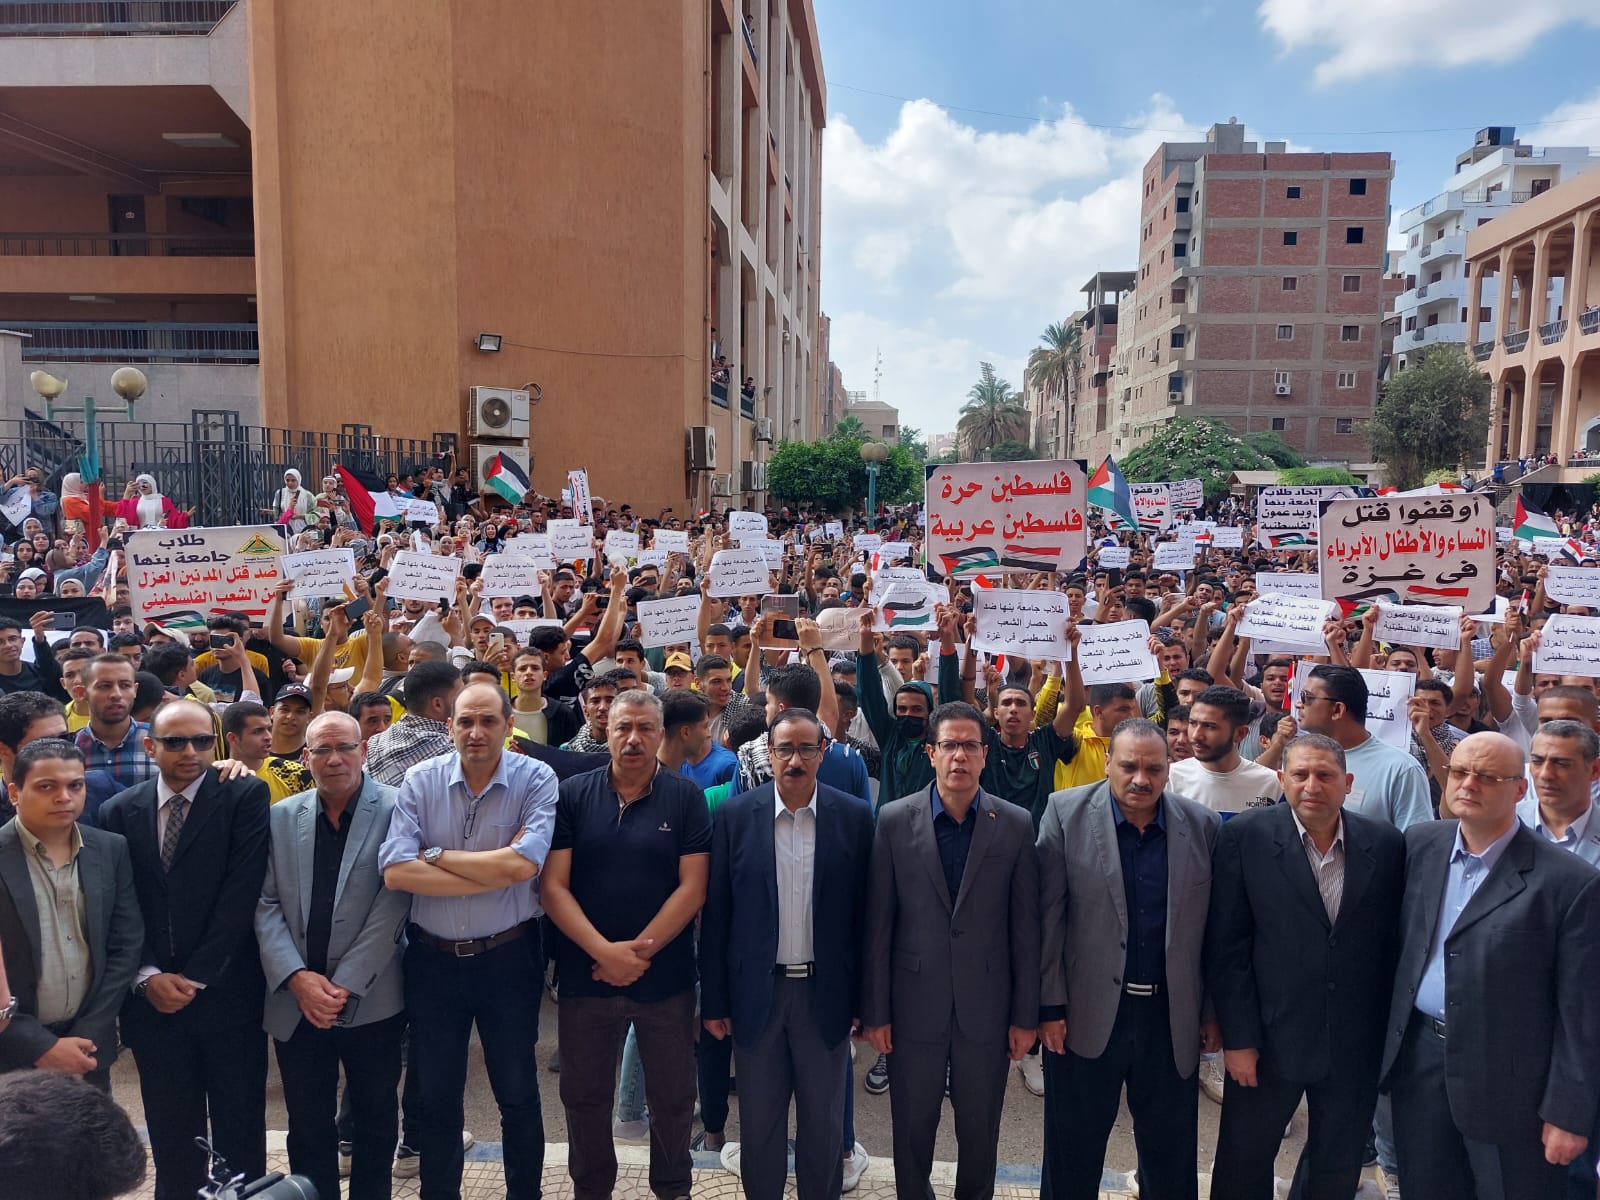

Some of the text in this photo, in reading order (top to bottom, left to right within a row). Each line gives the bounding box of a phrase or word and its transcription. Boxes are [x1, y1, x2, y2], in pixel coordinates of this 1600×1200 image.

[941, 470, 1072, 504] فلسطين حرة
[1264, 488, 1292, 497] طلاب
[1264, 499, 1285, 507] بنها
[1342, 497, 1479, 527] أوقفوا قتل
[930, 508, 1083, 542] فلسطين عربية
[159, 534, 205, 550] طلاب
[1327, 525, 1492, 562] النساء والأطفال الأبرياء
[133, 554, 170, 567] بنها
[174, 551, 231, 566] جامعة
[226, 565, 250, 583] قتل
[254, 564, 278, 580] ضد
[1342, 563, 1426, 588] غزة
[138, 569, 176, 588] العزل
[142, 590, 213, 612] الفلسطيني
[216, 587, 258, 605] الشعب
[1000, 603, 1014, 613] بنها
[1017, 602, 1040, 613] جامعة
[1043, 604, 1064, 614] طلاب
[997, 617, 1048, 629] حصار الشعب
[1122, 631, 1143, 642] طلاب
[1571, 625, 1596, 636] جامعة
[986, 631, 1057, 643] الفلسطيني في غزة
[1097, 635, 1119, 643] جامعة
[1082, 648, 1130, 658] حصار الشعب
[1080, 662, 1089, 671] غز
[1106, 659, 1142, 671] الفلسطيني
[1368, 686, 1391, 698] فلس
